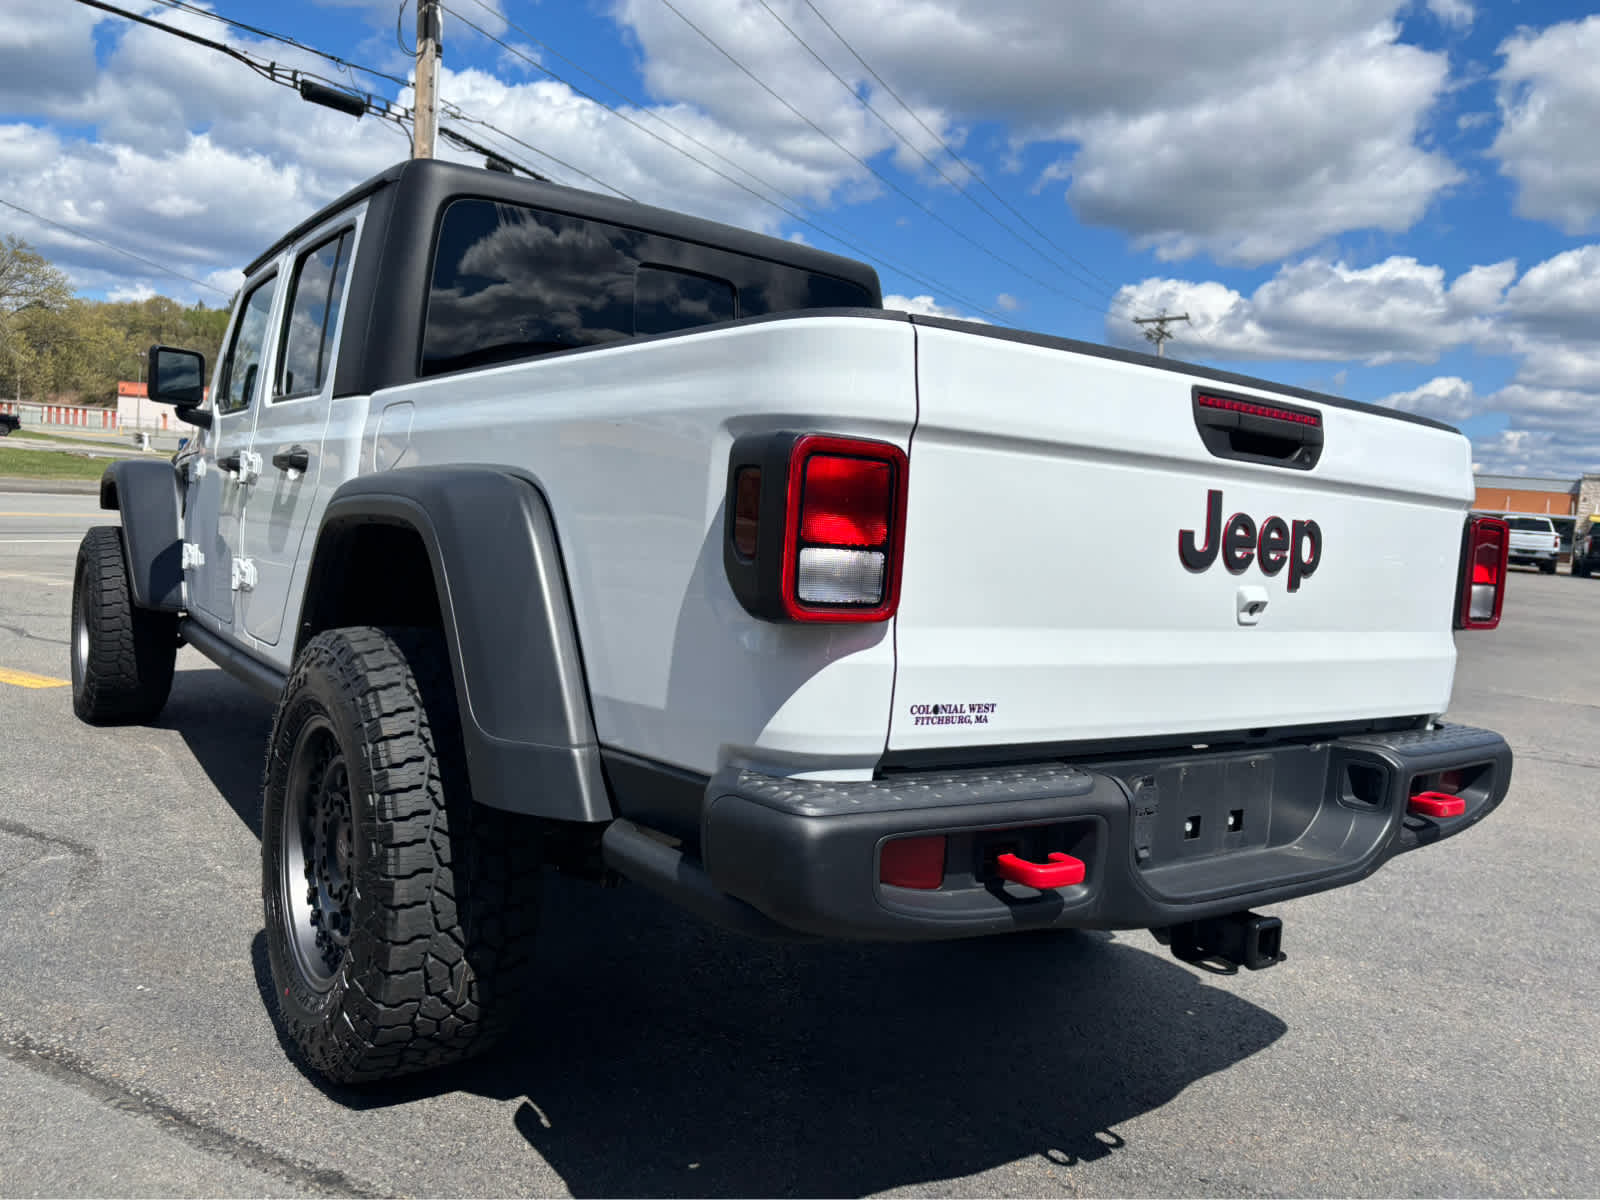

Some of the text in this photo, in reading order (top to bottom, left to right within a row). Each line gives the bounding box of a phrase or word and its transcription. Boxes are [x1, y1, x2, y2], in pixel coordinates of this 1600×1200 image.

[1178, 489, 1322, 593] Jeep
[968, 703, 997, 713] WEST
[914, 715, 989, 726] FITCHBURG, MA
